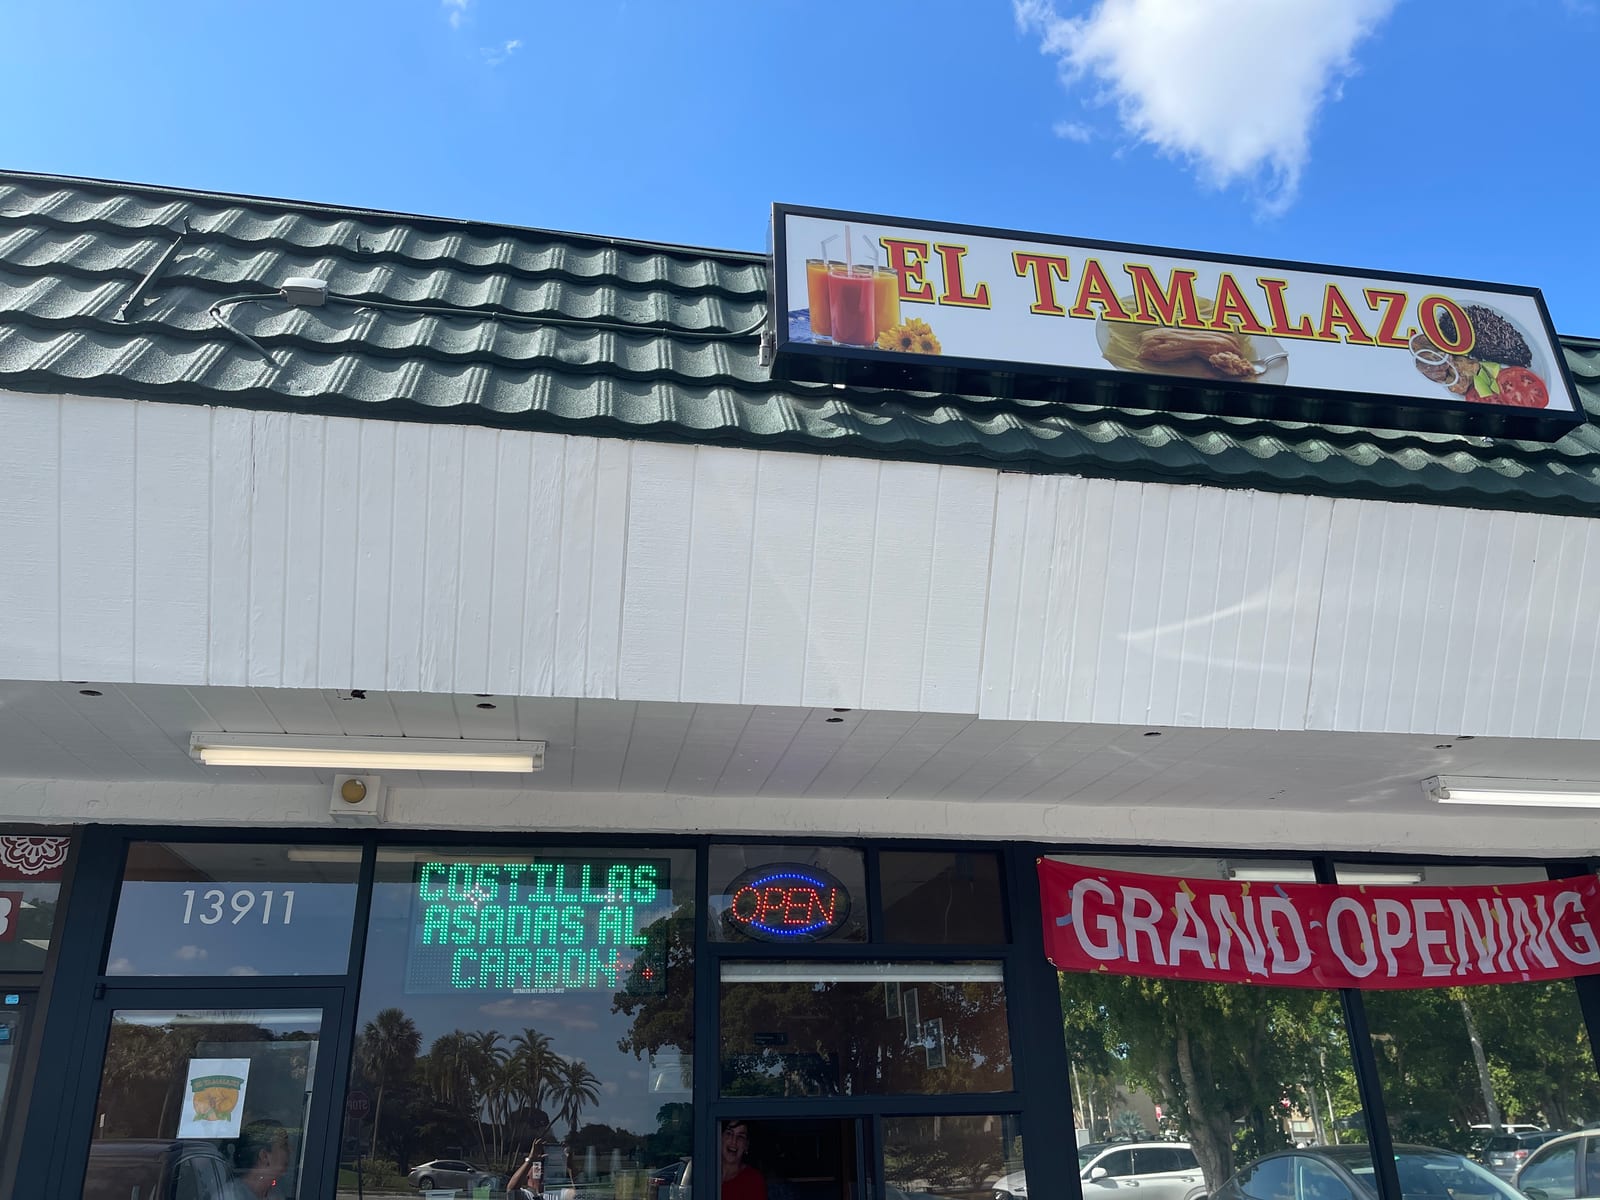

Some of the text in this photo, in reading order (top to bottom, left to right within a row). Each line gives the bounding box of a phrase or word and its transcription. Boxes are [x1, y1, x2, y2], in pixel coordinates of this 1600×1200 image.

[878, 236, 1476, 356] EL TAMALAZO
[419, 862, 657, 903] COSTILLAS
[181, 890, 295, 925] 13911
[422, 904, 648, 945] ASADAS AL
[732, 886, 836, 925] OPEN
[1071, 877, 1600, 977] GRAND OPENING
[451, 948, 617, 989] CARBON
